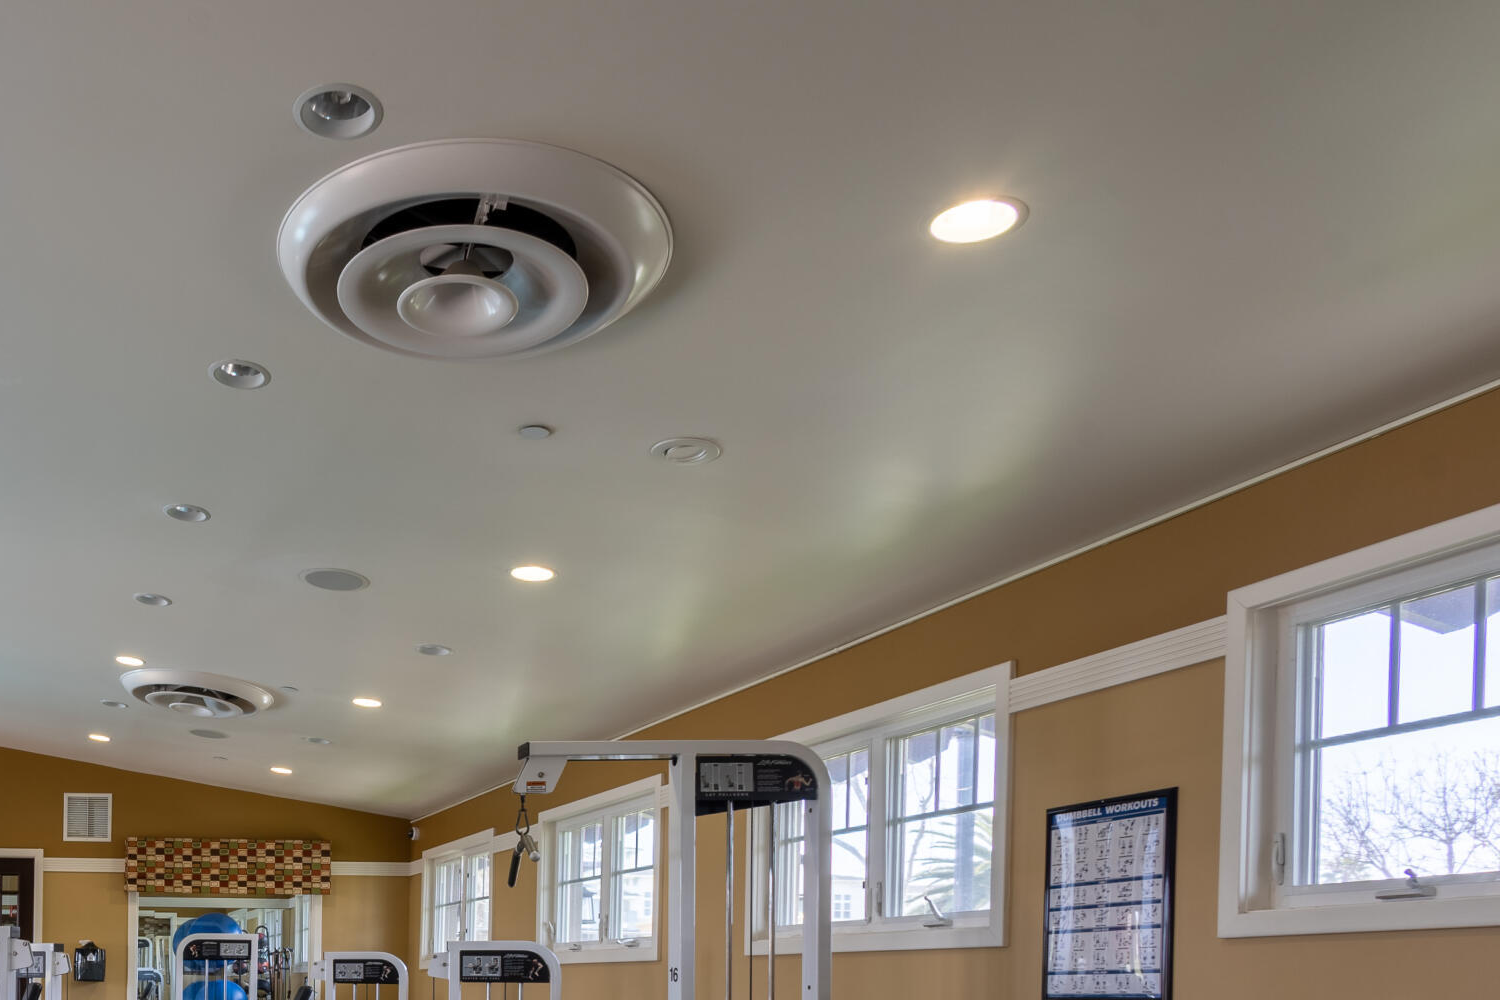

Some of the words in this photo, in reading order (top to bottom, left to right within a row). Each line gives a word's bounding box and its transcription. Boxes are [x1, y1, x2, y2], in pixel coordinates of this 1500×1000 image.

[1056, 807, 1102, 822] DUMBBELL
[1105, 798, 1159, 814] WORKOUTS
[669, 967, 679, 982] 16
